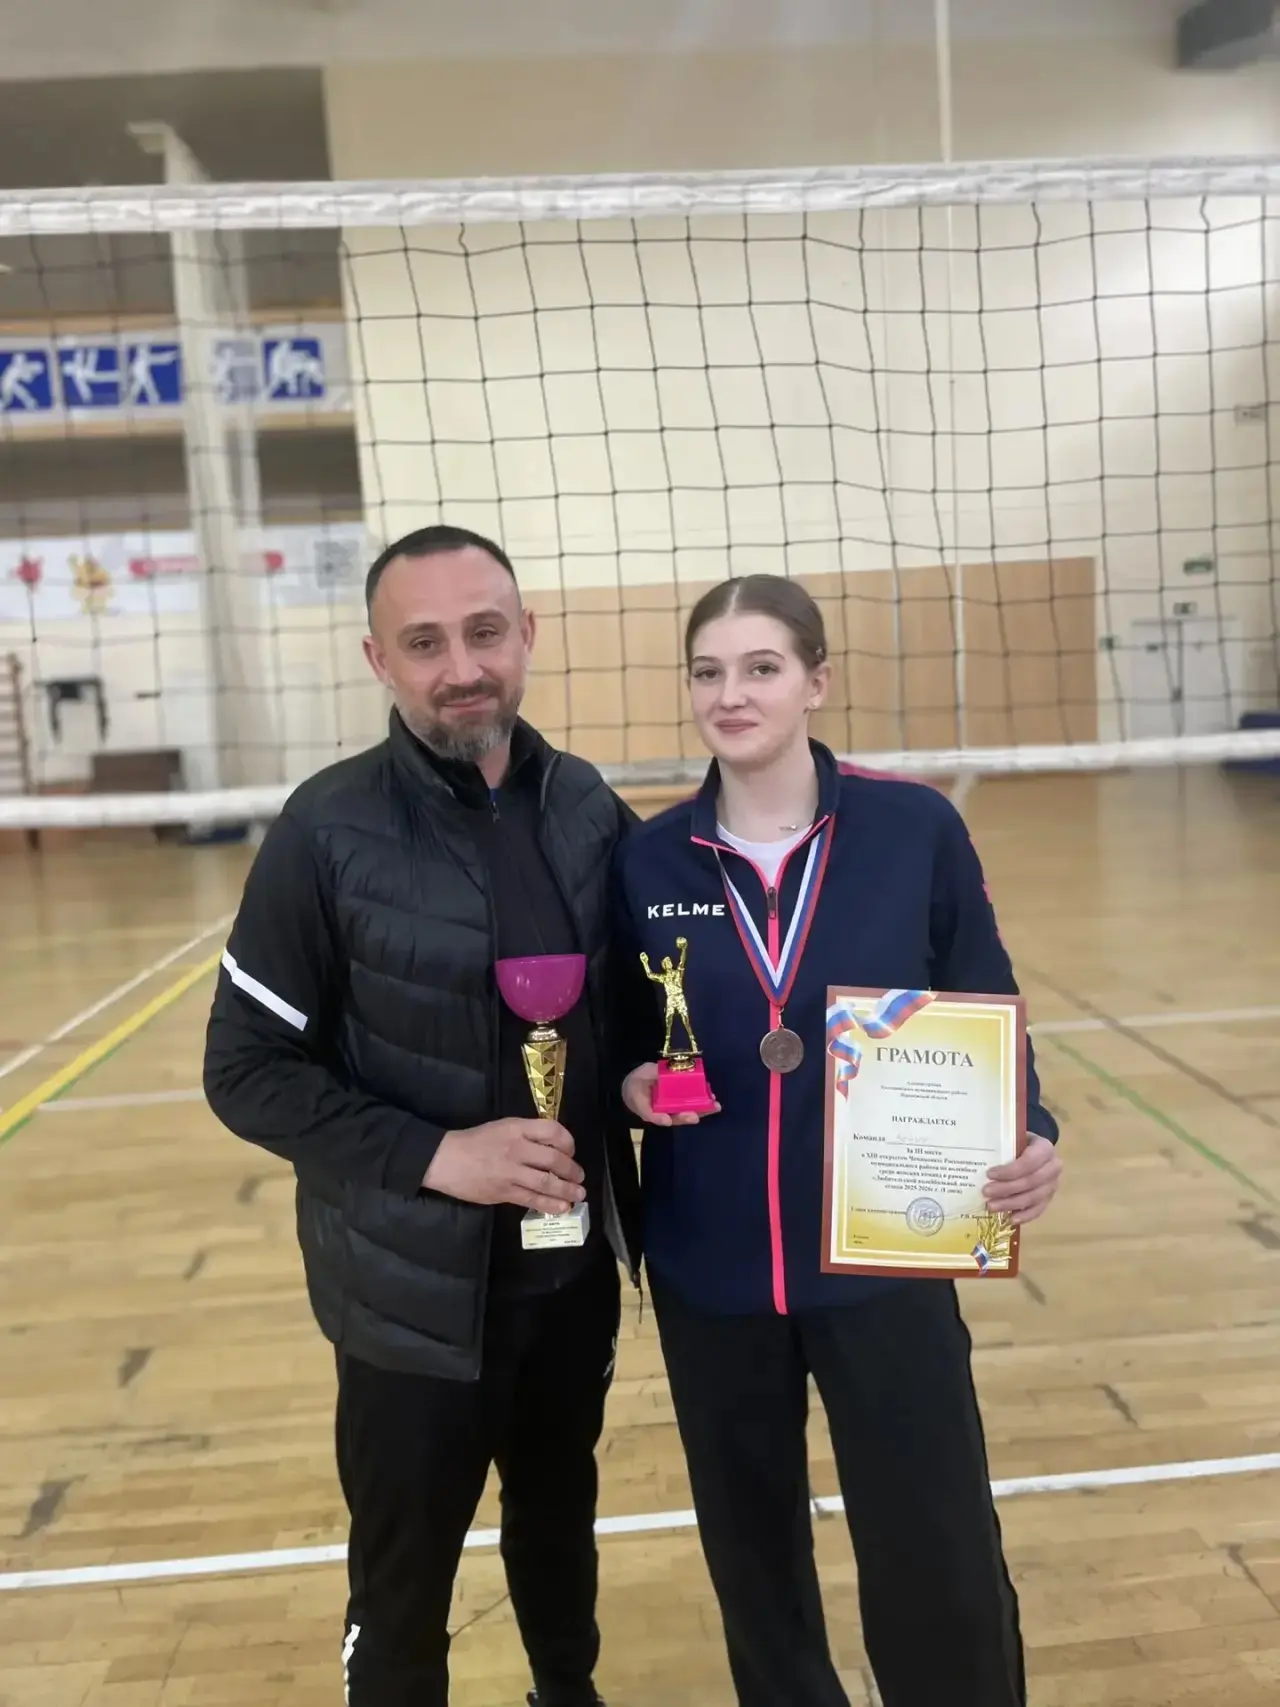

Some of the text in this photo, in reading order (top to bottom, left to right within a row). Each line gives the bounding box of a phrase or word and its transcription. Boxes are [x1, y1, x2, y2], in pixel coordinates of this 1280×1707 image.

[647, 902, 725, 919] KELME
[876, 1047, 974, 1067] ГРАМОТА
[891, 1115, 956, 1126] НАГРАЖДАЕТСЯ
[853, 1133, 886, 1142] Команда
